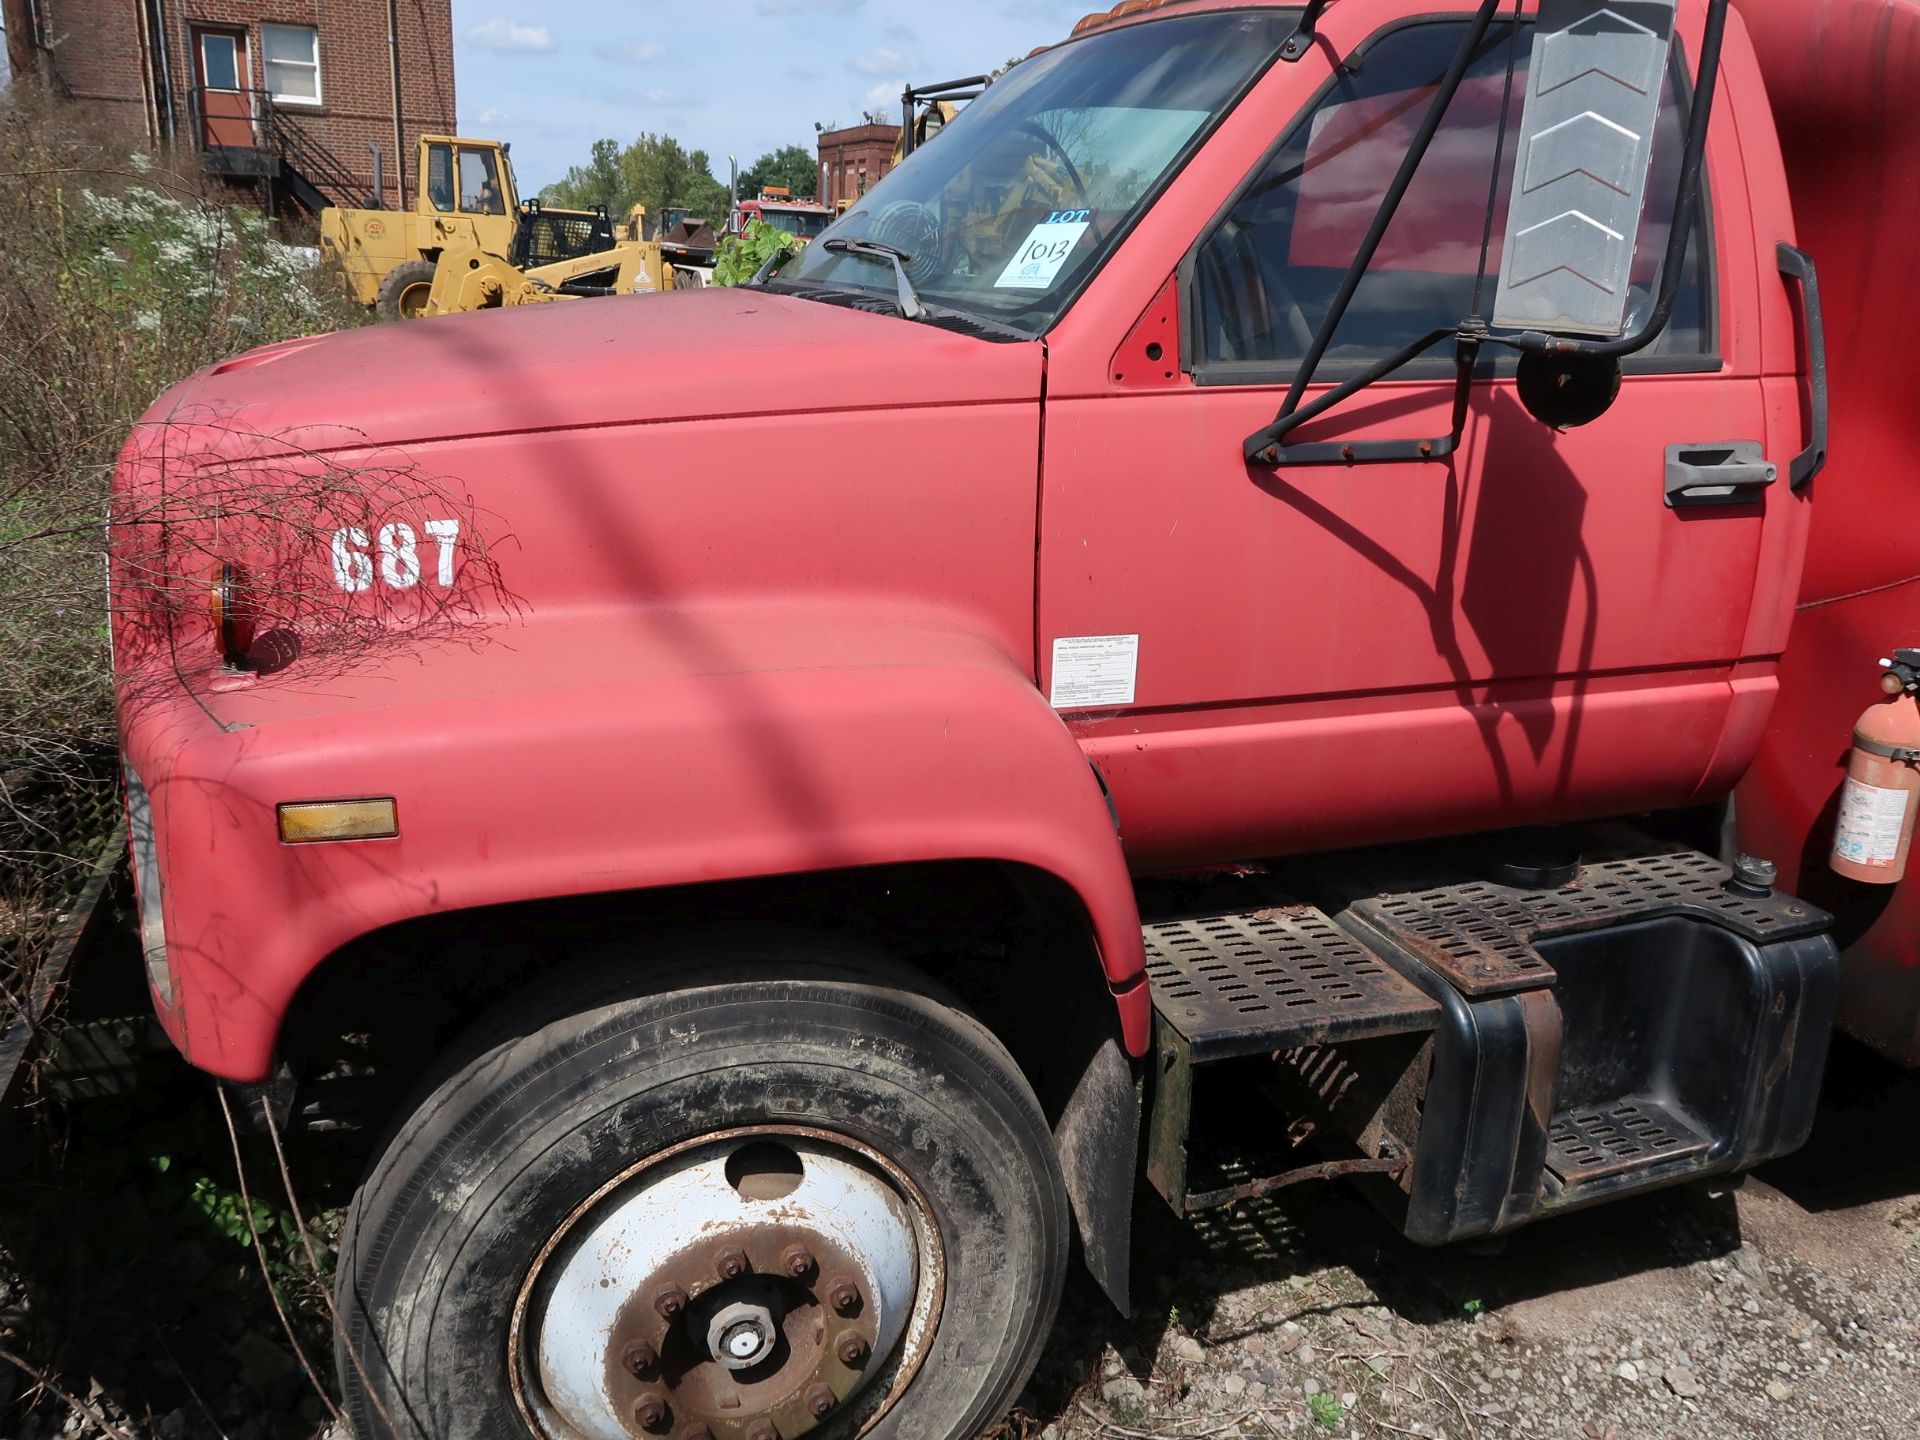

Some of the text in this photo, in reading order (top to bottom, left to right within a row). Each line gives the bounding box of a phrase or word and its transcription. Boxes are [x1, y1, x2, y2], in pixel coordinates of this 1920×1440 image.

[1046, 210, 1090, 224] LOT
[1020, 240, 1070, 264] 1013
[332, 519, 460, 592] 687
